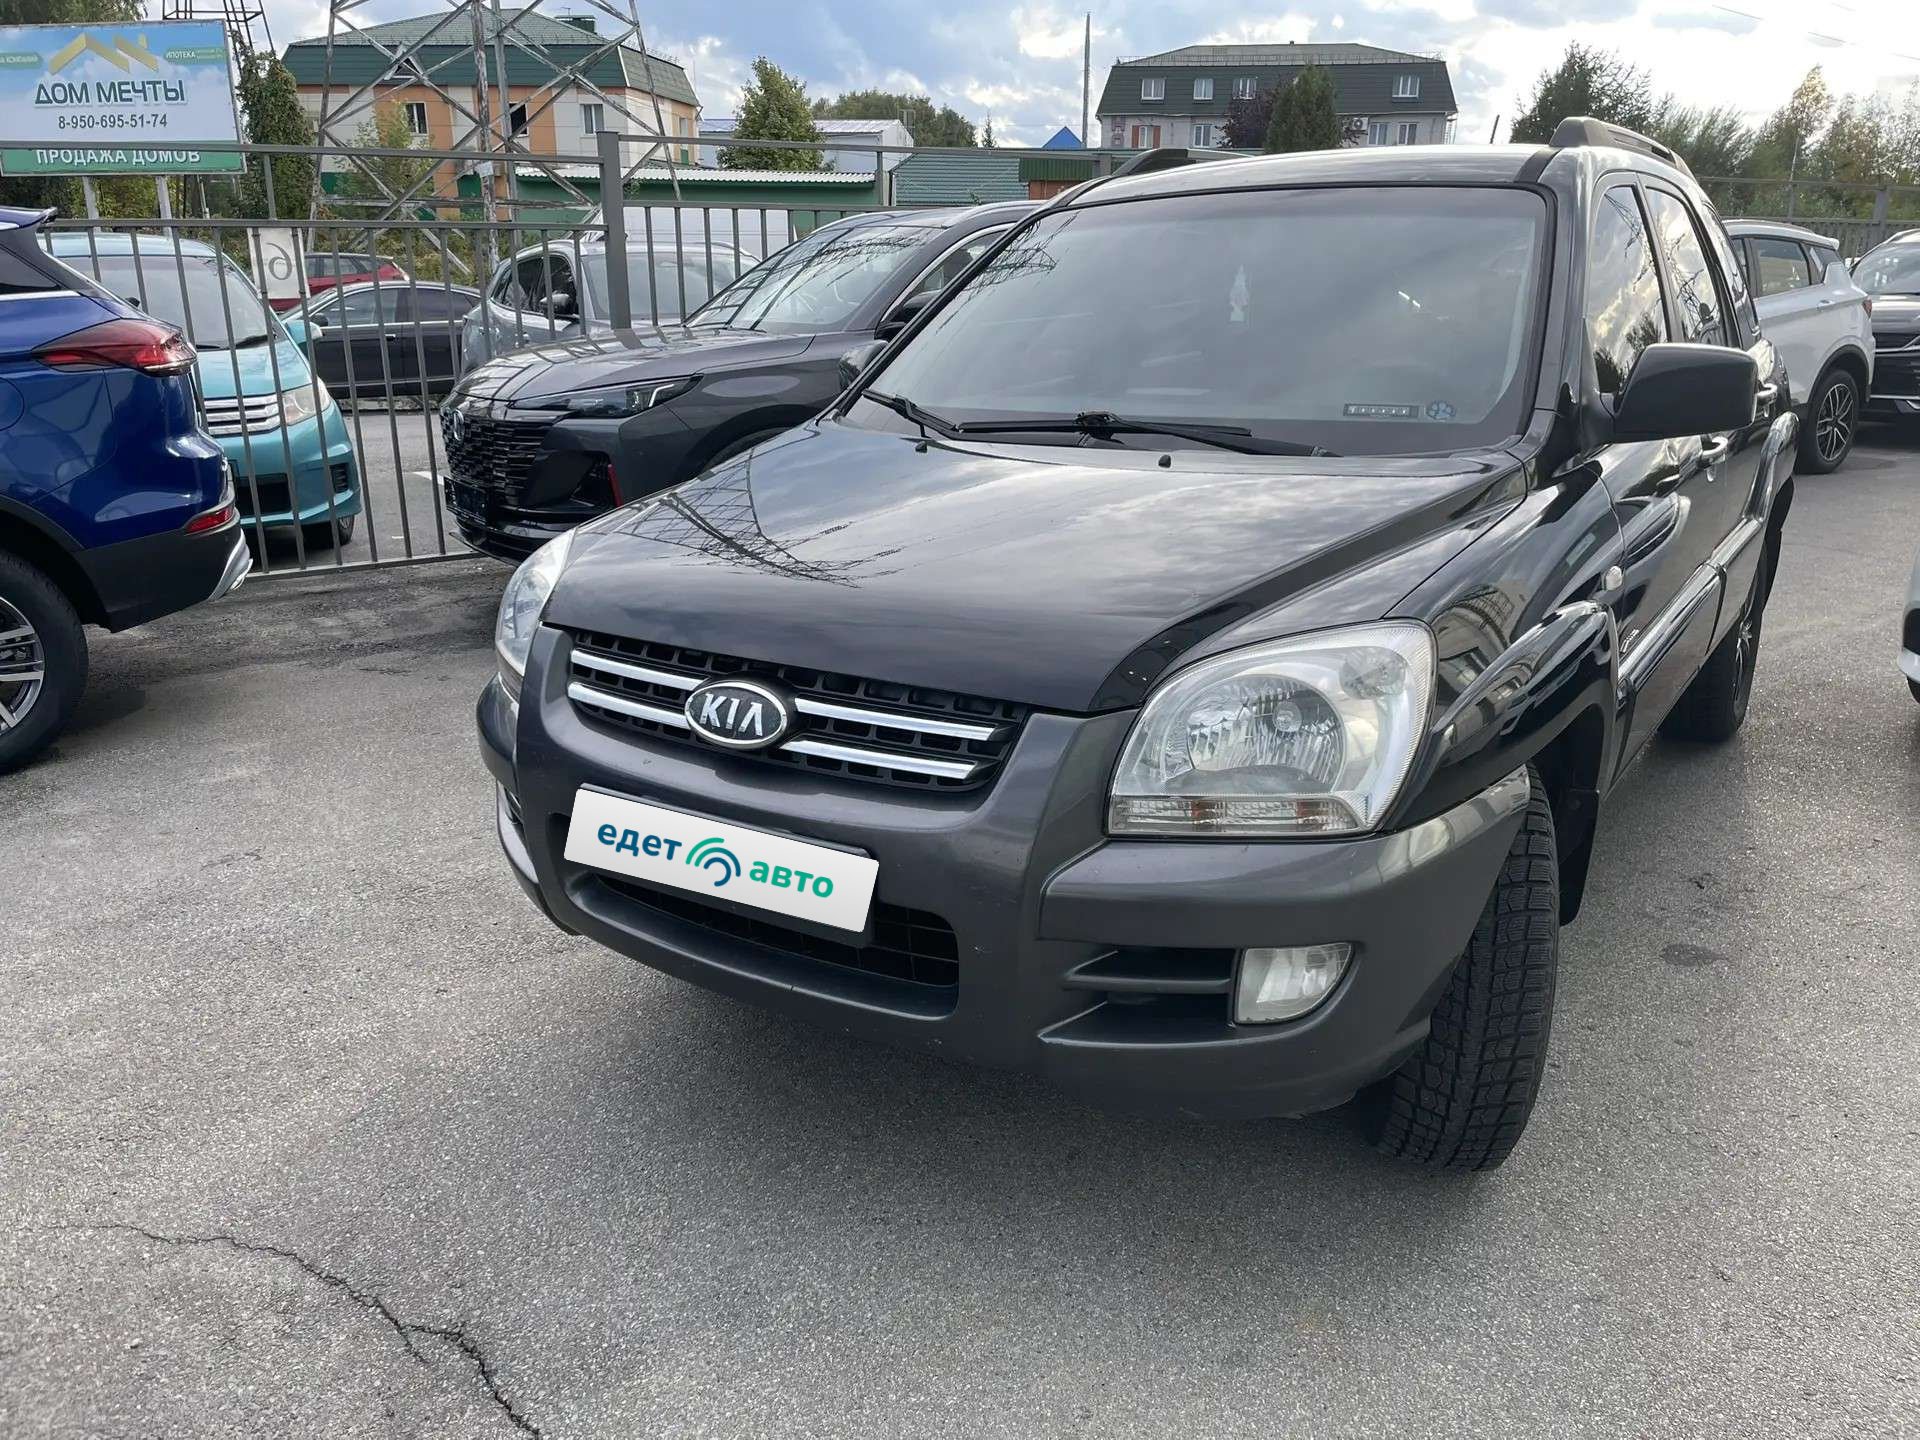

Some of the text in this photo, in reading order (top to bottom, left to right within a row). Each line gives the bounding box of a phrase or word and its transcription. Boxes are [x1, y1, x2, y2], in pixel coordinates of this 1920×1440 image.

[35, 80, 185, 105] ДОМ МЕЧТЫ
[58, 114, 168, 129] 8-950-695-51-74
[36, 149, 201, 166] ПРОДАЖА ДОМОВ
[699, 692, 764, 737] KIA
